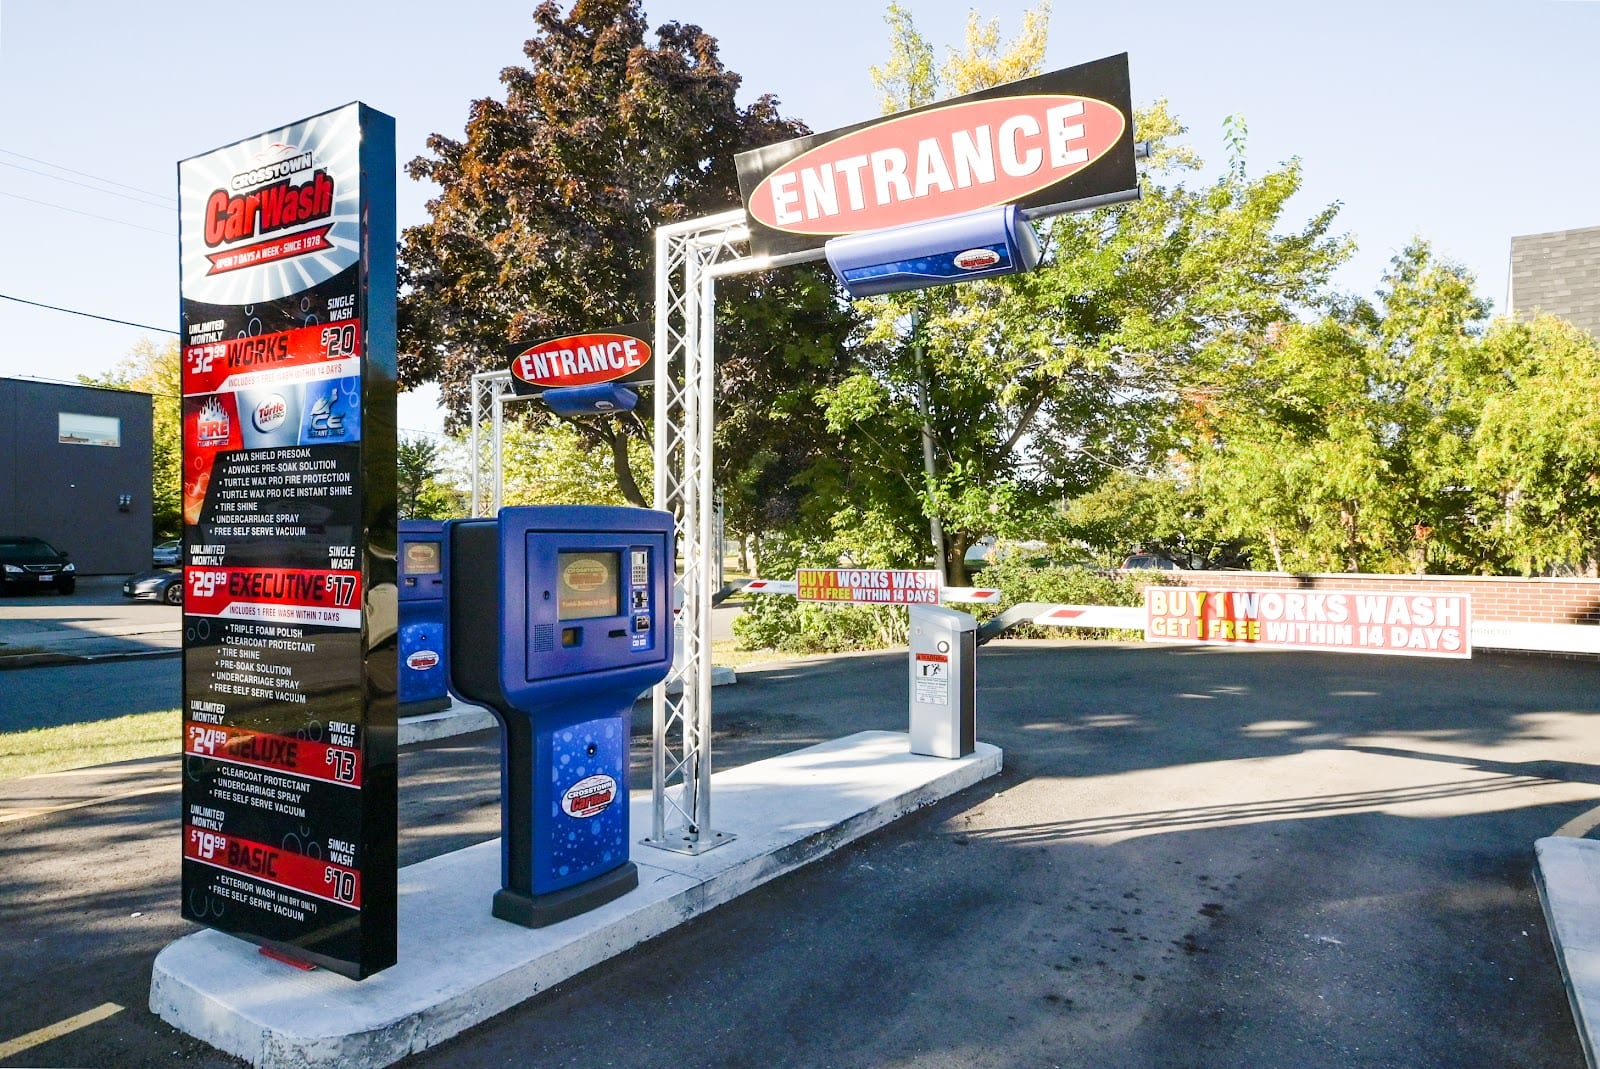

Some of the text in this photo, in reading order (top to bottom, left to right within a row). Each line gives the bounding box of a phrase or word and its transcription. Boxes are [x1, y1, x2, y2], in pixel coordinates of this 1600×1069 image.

[232, 152, 312, 190] CROSSTOWN
[769, 101, 1090, 226] ENTRANCE
[234, 256, 238, 265] 7
[239, 252, 255, 264] DAYS
[255, 251, 260, 260] A
[262, 246, 279, 259] WEEK
[284, 240, 301, 253] SINCE
[303, 235, 320, 249] 1978
[328, 294, 354, 310] SINGLE
[330, 308, 352, 322] WASH
[189, 320, 224, 335] UNLIMITED
[190, 330, 224, 345] MONTHLY
[321, 325, 356, 358] $20
[228, 335, 289, 368] WORKS
[520, 339, 640, 380] ENTRANCE
[229, 376, 254, 387] INCLUDES
[326, 364, 342, 375] DAYS
[259, 402, 284, 418] Turtle
[200, 420, 228, 437] FIRE
[232, 448, 311, 462] LAVA SHIELD PRESOAK
[228, 460, 336, 474] ADVANCE PRE-SOAK SOLUTION
[224, 472, 350, 487] TURTLE WAX PRO FIRE PROTECTION
[222, 486, 352, 499] TURTLE WAX PRO ICE INSTANT SHINE
[221, 502, 258, 511] TIRE SHINE
[217, 514, 299, 524] UNDERCARRIAGE SPRAY
[214, 527, 306, 536] FREE SELF SERVE VACUUM
[190, 544, 225, 555] UNLIMITED
[328, 546, 356, 557] SINGLE
[192, 556, 224, 566] MONTHLY
[331, 558, 353, 570] WASH
[229, 572, 324, 600] EXECUTIVE
[800, 572, 936, 590] BUY 1 WORKS WASH
[326, 574, 356, 606] $17
[800, 588, 935, 602] GET 1 FREE WITHIN 14 DAYS
[230, 605, 340, 622] INCLUDES 1 FREE WASH WITHIN 7 DAYS
[1151, 590, 1461, 627] BUY 1 WORKS WASH
[230, 624, 302, 638] TRIPLE FOAM POLISH
[1151, 618, 1462, 651] GET 1 FREE WITHIN 14 DAYS
[226, 636, 315, 652] CLEARCOAT PROTECTANT
[222, 648, 260, 660] TIRE SHINE
[220, 660, 291, 676] PRE-SOAK SOLUTION
[217, 672, 299, 690] UNDERCARRIAGE SPRAY
[214, 683, 306, 704] FREE SELF SERVE VACUUM
[190, 700, 225, 714] UNLIMITED
[192, 711, 224, 724] MONTHLY
[328, 721, 356, 735] SINGLE
[331, 734, 353, 747] WASH
[229, 732, 298, 767] DELUXE
[326, 747, 356, 782] $13
[222, 766, 310, 793] CLEARCOAT PROTECTANT
[218, 778, 301, 804] UNDERCARRIAGE SPRAY
[568, 780, 612, 799] CROSSTOWN
[214, 789, 305, 818] FREE SELF SERVE VACUUM
[190, 804, 224, 821] UNLIMITED
[192, 816, 223, 832] MONTHLY
[328, 838, 355, 855] SINGLE
[228, 842, 278, 878] BASIC
[330, 852, 353, 867] WASH
[221, 875, 254, 892] EXTERIOR
[255, 884, 276, 900] WASH
[325, 866, 356, 903] $10
[213, 886, 304, 922] FREE SELF SERVE VACUUM
